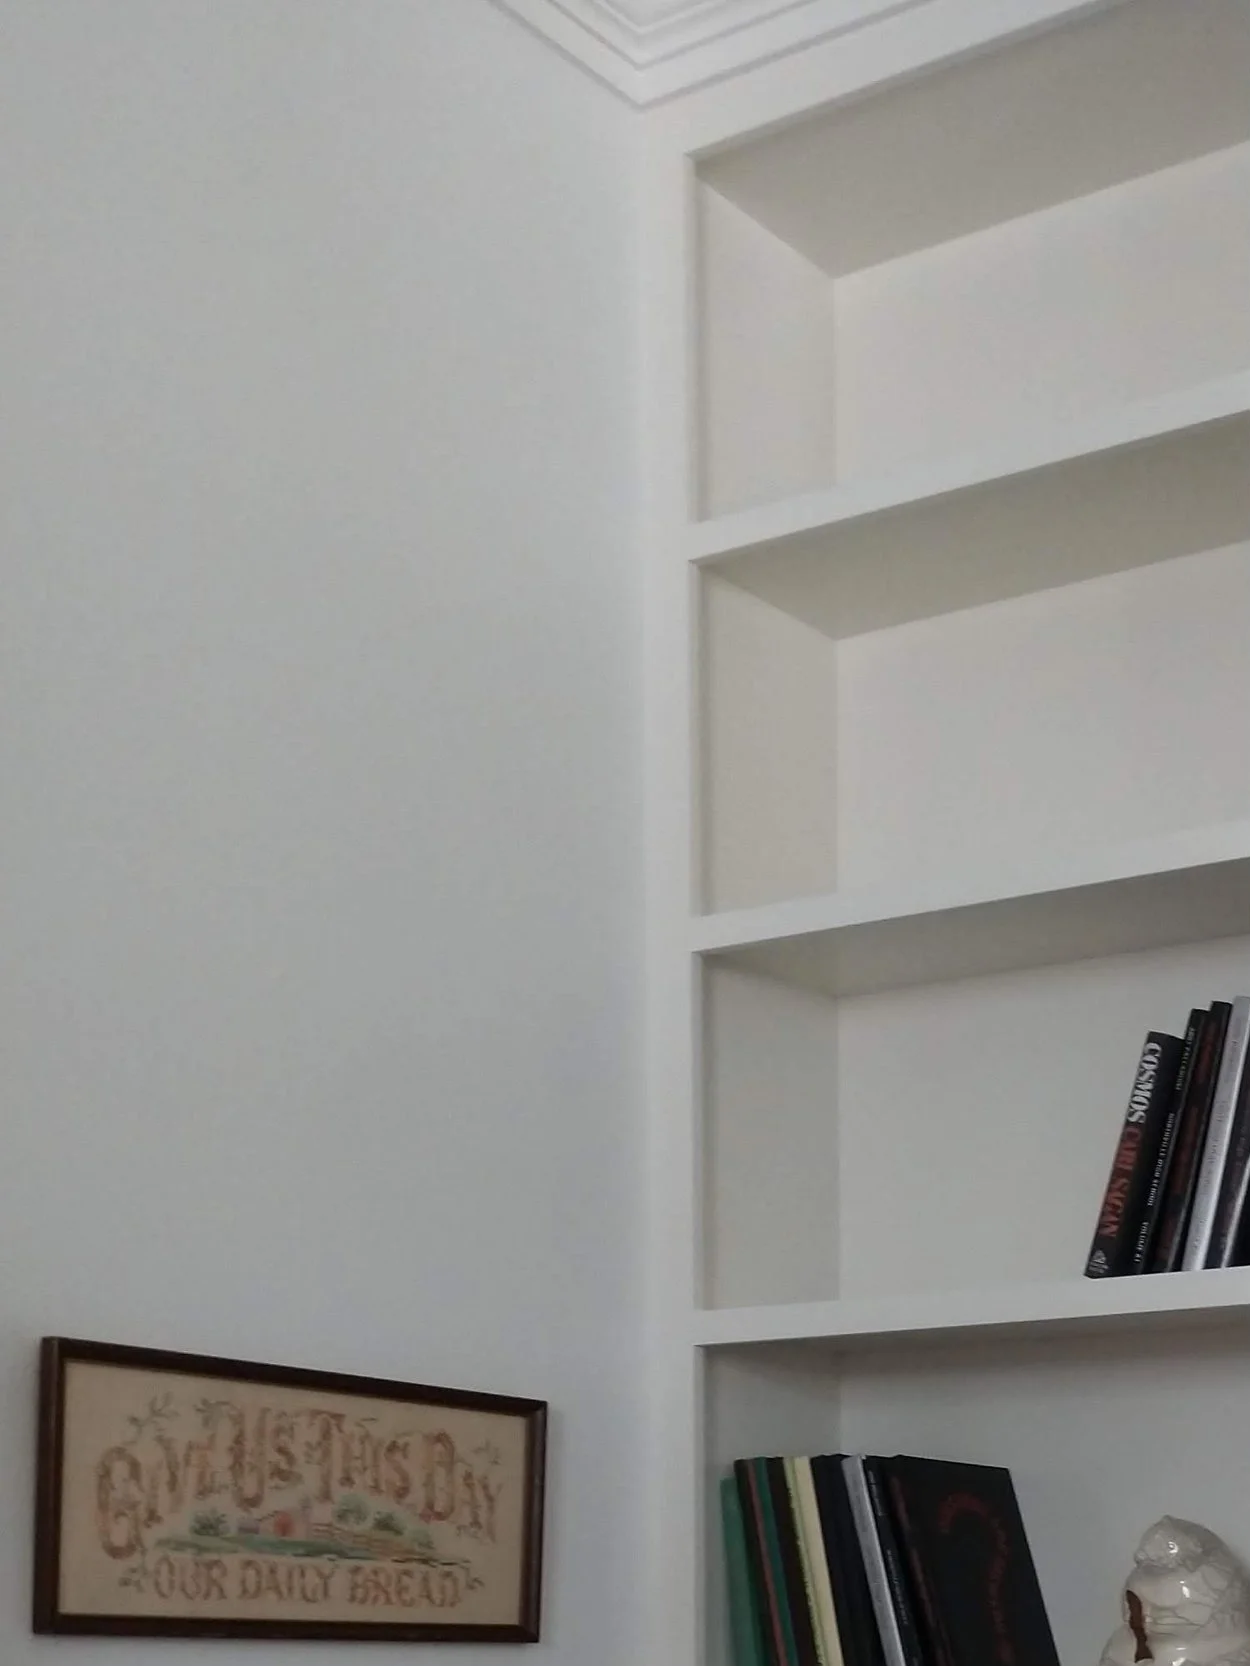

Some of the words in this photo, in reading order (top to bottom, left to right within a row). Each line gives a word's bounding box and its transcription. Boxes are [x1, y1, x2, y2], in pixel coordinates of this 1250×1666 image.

[1127, 1041, 1162, 1124] COSMOS
[97, 1430, 225, 1561] GIVE
[215, 1400, 302, 1510] US
[300, 1408, 411, 1505] THIS
[420, 1428, 502, 1543] DAY
[153, 1558, 229, 1601] OUR
[238, 1559, 335, 1604] DAILY
[347, 1563, 464, 1609] BREAD
